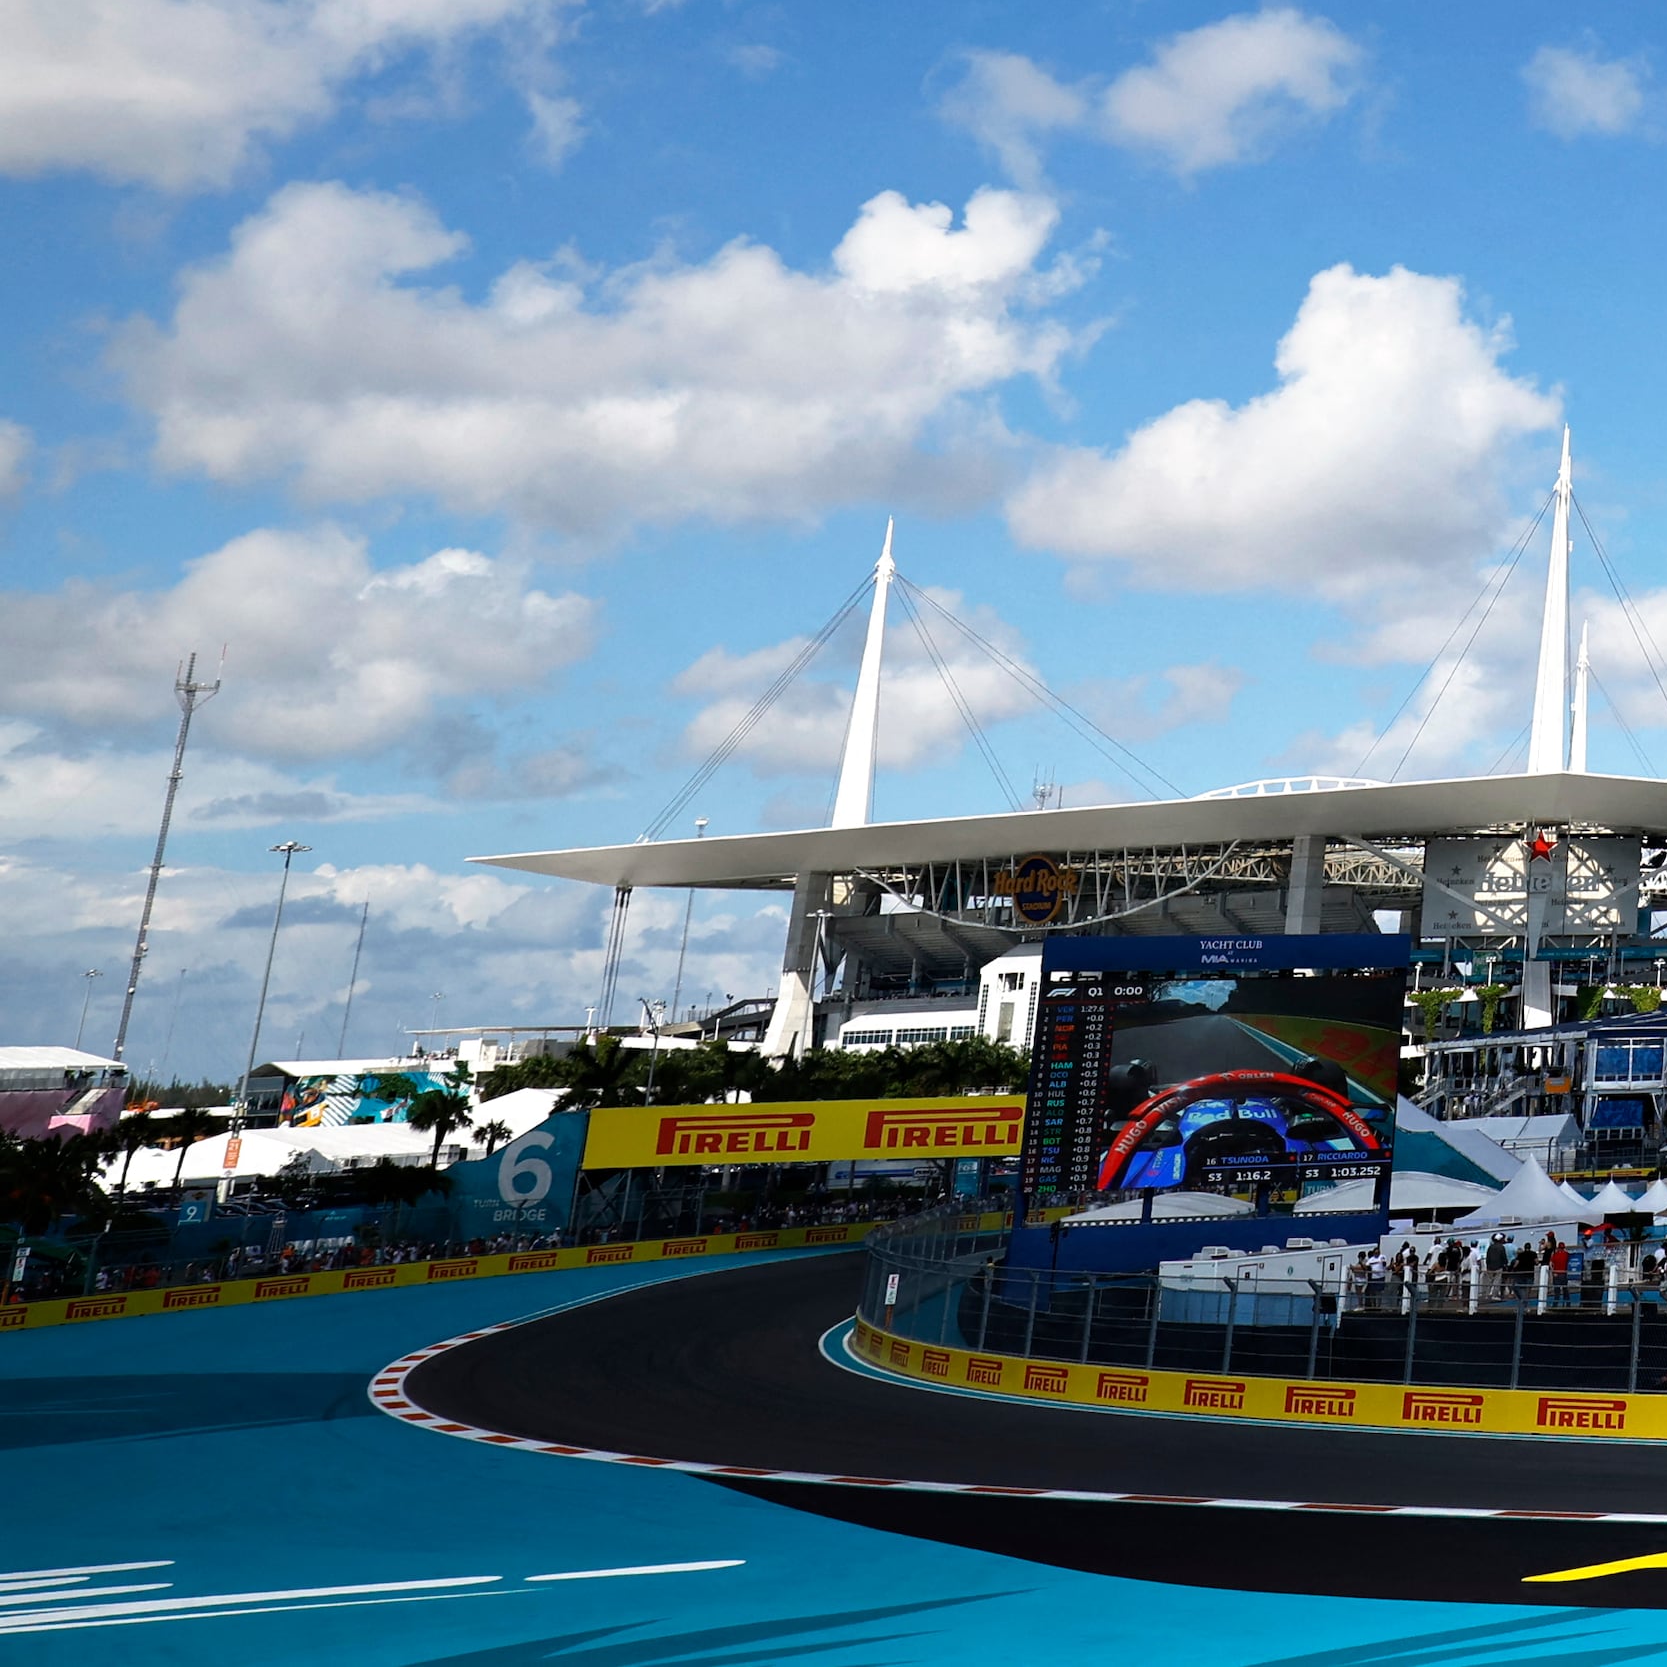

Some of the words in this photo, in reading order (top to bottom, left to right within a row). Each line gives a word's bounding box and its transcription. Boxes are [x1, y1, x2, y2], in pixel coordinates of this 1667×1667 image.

[994, 871, 1032, 894] Hard
[1036, 869, 1079, 896] Rock
[1200, 940, 1234, 950] YACHT
[1236, 940, 1262, 949] CLUB
[1088, 987, 1103, 997] Q1
[1114, 987, 1142, 995] 0:00
[1238, 1072, 1274, 1080] ORLEN
[1238, 1109, 1278, 1120] Bull
[1342, 1111, 1370, 1138] HUGO
[656, 1113, 815, 1155] PIRELLI
[864, 1107, 1024, 1149] PIRELLI
[1115, 1120, 1148, 1154] HUGO
[1220, 1156, 1269, 1164] TSUNODA
[1303, 1154, 1313, 1162] 17
[1317, 1152, 1368, 1161] RICCIARDO
[498, 1130, 554, 1208] 6
[1208, 1172, 1222, 1182] S3
[1236, 1170, 1272, 1182] 1:16.2
[1305, 1169, 1320, 1178] S3
[1330, 1166, 1381, 1178] 1:03.252
[186, 1206, 198, 1222] 9
[735, 1234, 778, 1249] PIRELLI
[806, 1228, 848, 1243] PIRELLI
[586, 1246, 634, 1264] PIRELLI
[662, 1239, 707, 1257] PIRELLI
[428, 1260, 478, 1279] PIRELLI
[508, 1252, 558, 1271] PIRELLI
[254, 1278, 310, 1298] PIRELLI
[344, 1268, 396, 1288] PIRELLI
[163, 1286, 221, 1308] PIRELLI
[65, 1296, 127, 1319] PIRELLI
[966, 1358, 1002, 1386] PIRELLI
[1024, 1364, 1069, 1394] PIRELLI
[1096, 1373, 1149, 1402] PIRELLI
[1184, 1379, 1246, 1410] PIRELLI
[1284, 1386, 1356, 1418] PIRELLI
[1402, 1392, 1484, 1424] PIRELLI
[1536, 1397, 1627, 1430] PIRELLI
